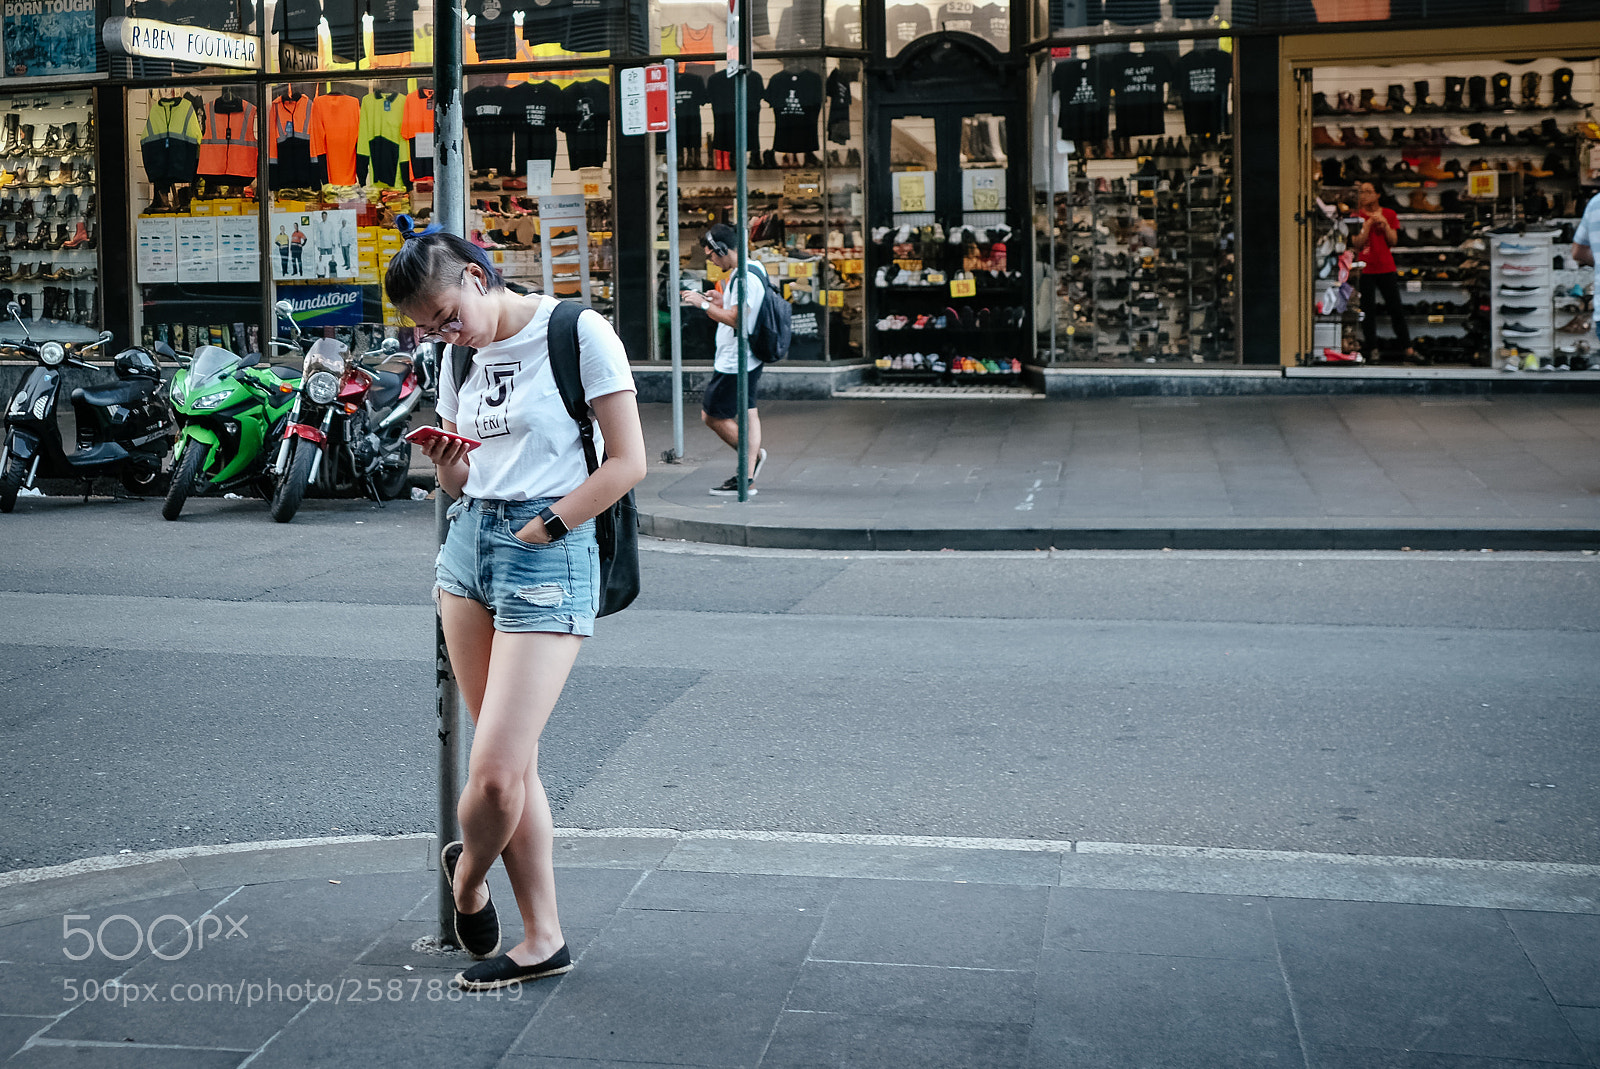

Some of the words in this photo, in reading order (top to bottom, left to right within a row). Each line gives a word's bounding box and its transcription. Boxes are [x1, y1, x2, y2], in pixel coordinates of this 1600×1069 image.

[5, 1, 42, 17] BORN
[132, 26, 175, 51] RABEN
[188, 33, 255, 62] FOOTWEAR
[628, 73, 639, 81] 2P
[651, 69, 662, 80] NO
[283, 291, 357, 312] lundstone
[485, 370, 515, 407] 5
[483, 413, 500, 431] FRI
